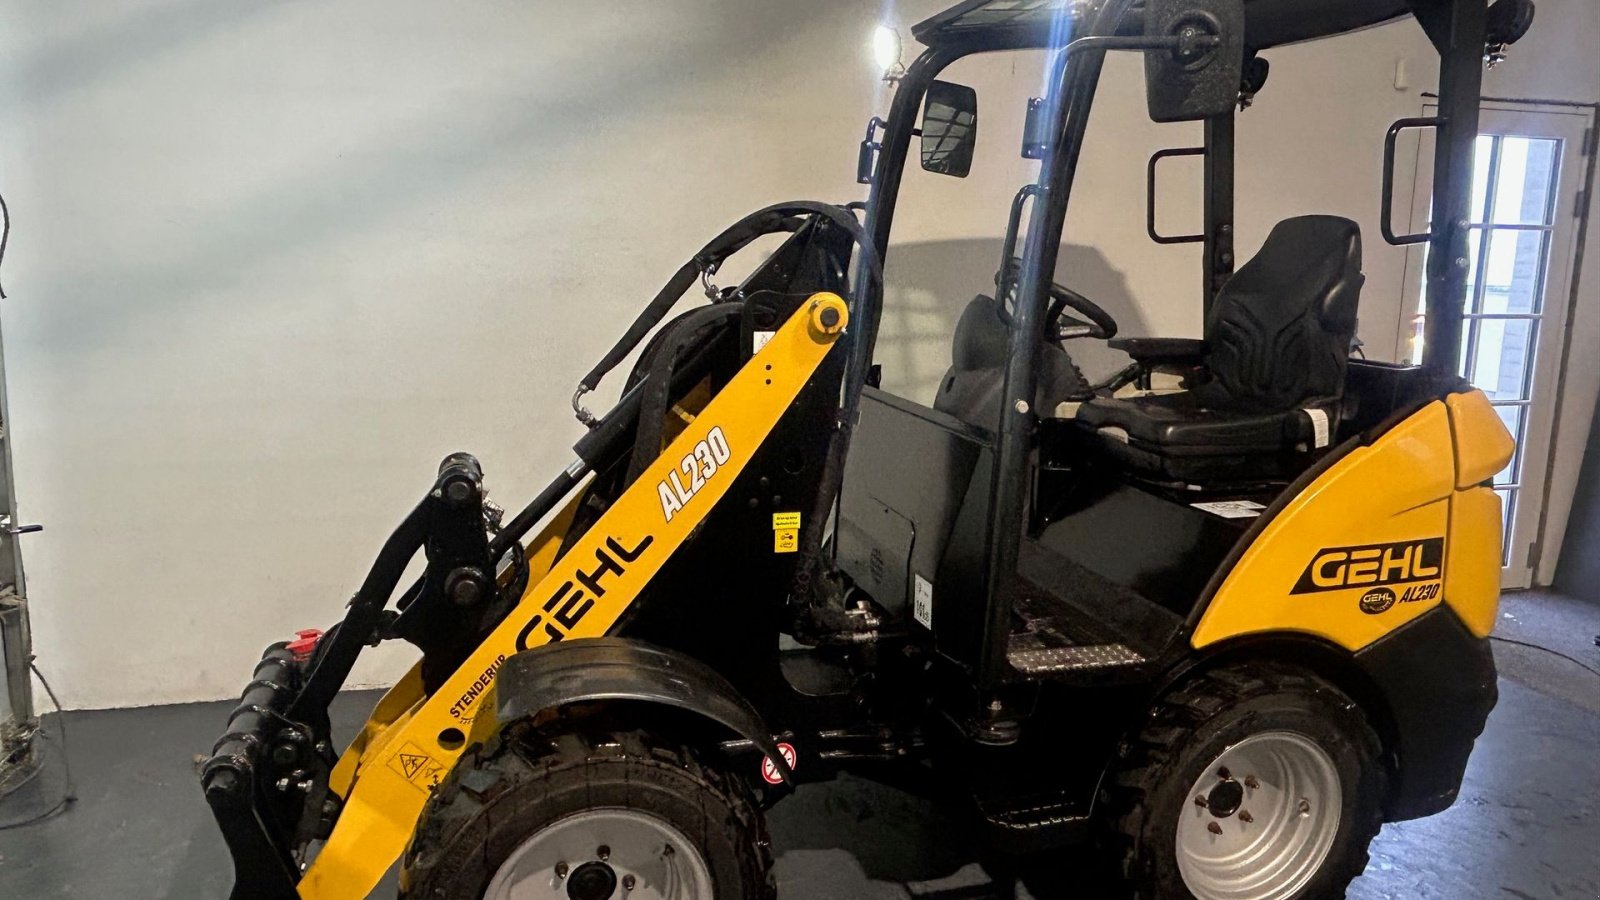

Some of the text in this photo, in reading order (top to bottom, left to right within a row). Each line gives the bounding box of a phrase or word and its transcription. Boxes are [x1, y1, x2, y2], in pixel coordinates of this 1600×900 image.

[657, 425, 731, 524] AL230
[1311, 544, 1438, 587] GEHL
[515, 535, 654, 652] GEHL
[1363, 592, 1393, 603] GEHL
[1398, 583, 1440, 604] AL230
